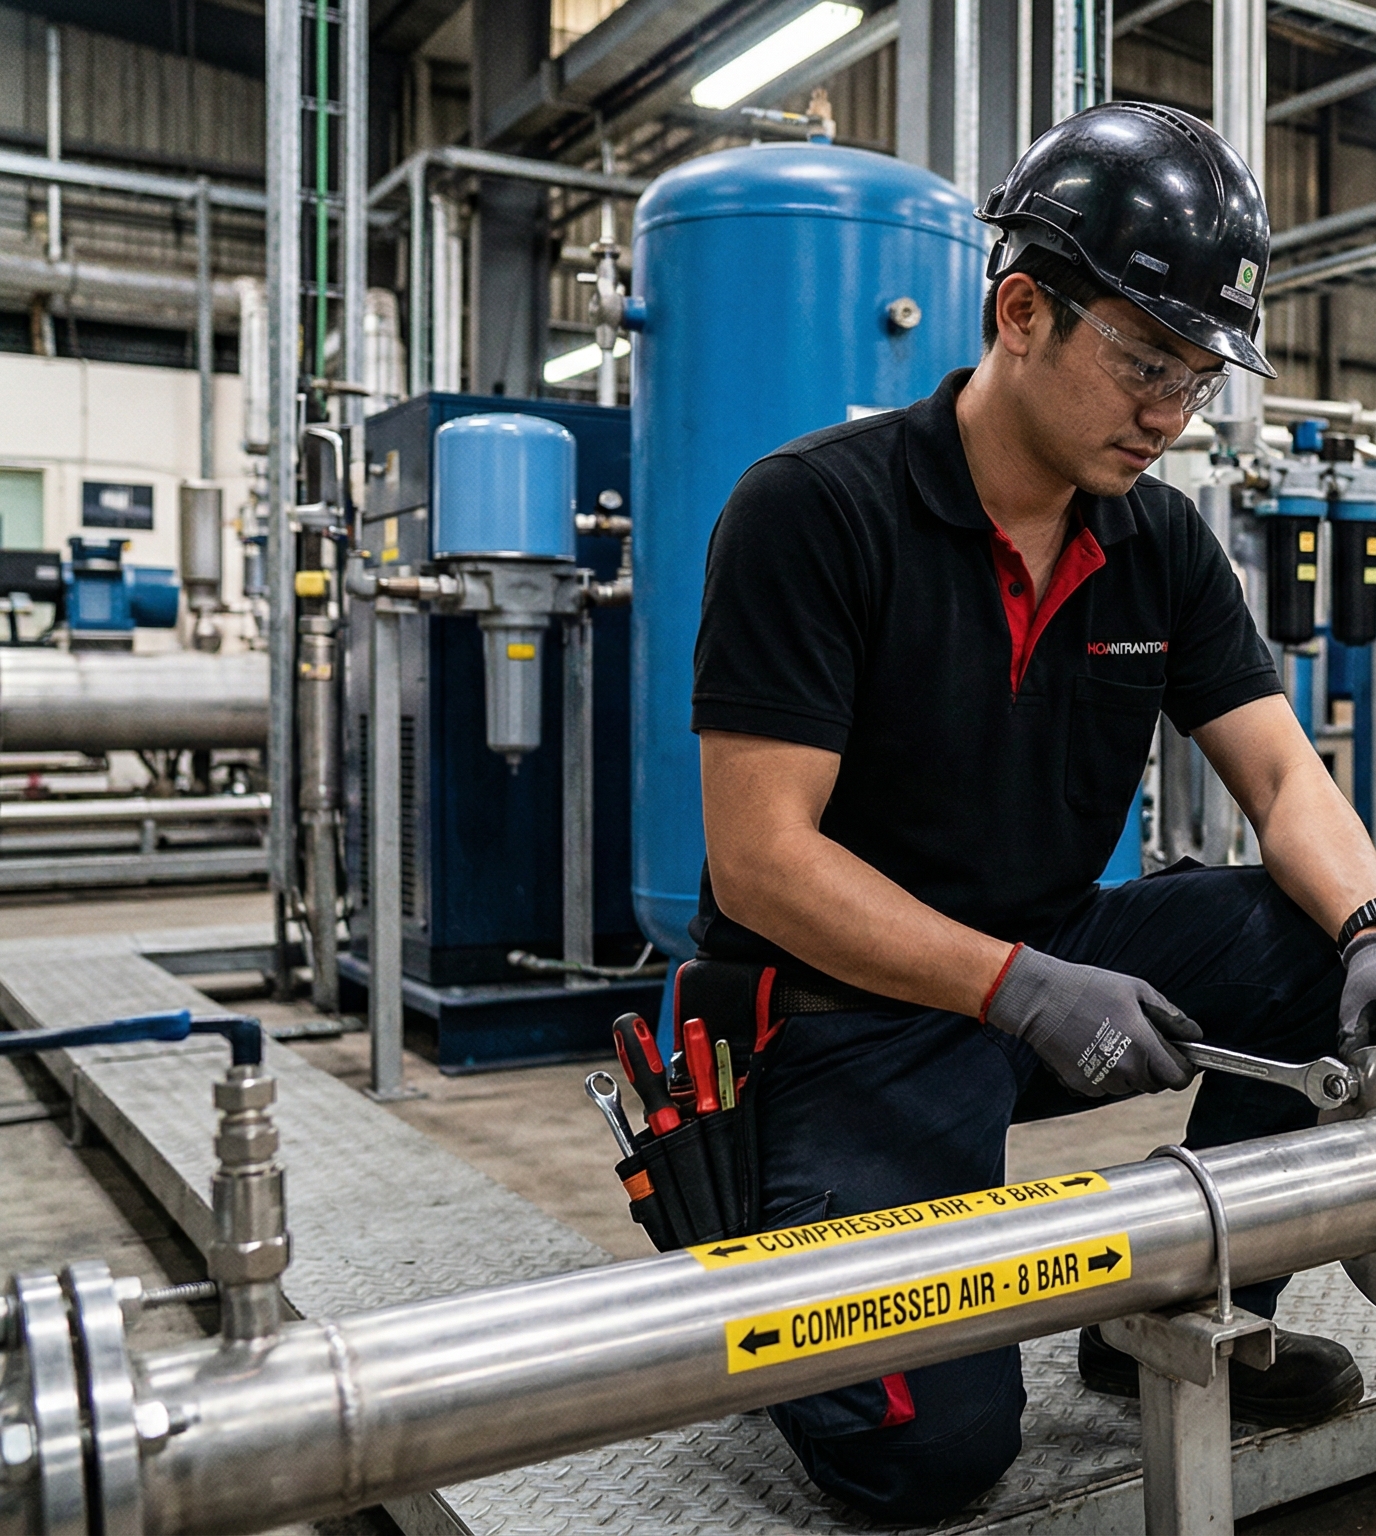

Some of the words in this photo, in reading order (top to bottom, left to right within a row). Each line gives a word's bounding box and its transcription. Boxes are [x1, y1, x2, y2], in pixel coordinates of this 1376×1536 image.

[756, 1207, 924, 1252] COMPRESSED
[928, 1198, 973, 1219] AIR
[986, 1191, 1007, 1206] 8
[1005, 1181, 1059, 1202] BAR
[791, 1282, 951, 1349] COMPRESSED
[958, 1271, 996, 1311] AIR
[1017, 1263, 1030, 1296] 8
[1036, 1252, 1080, 1292] BAR
